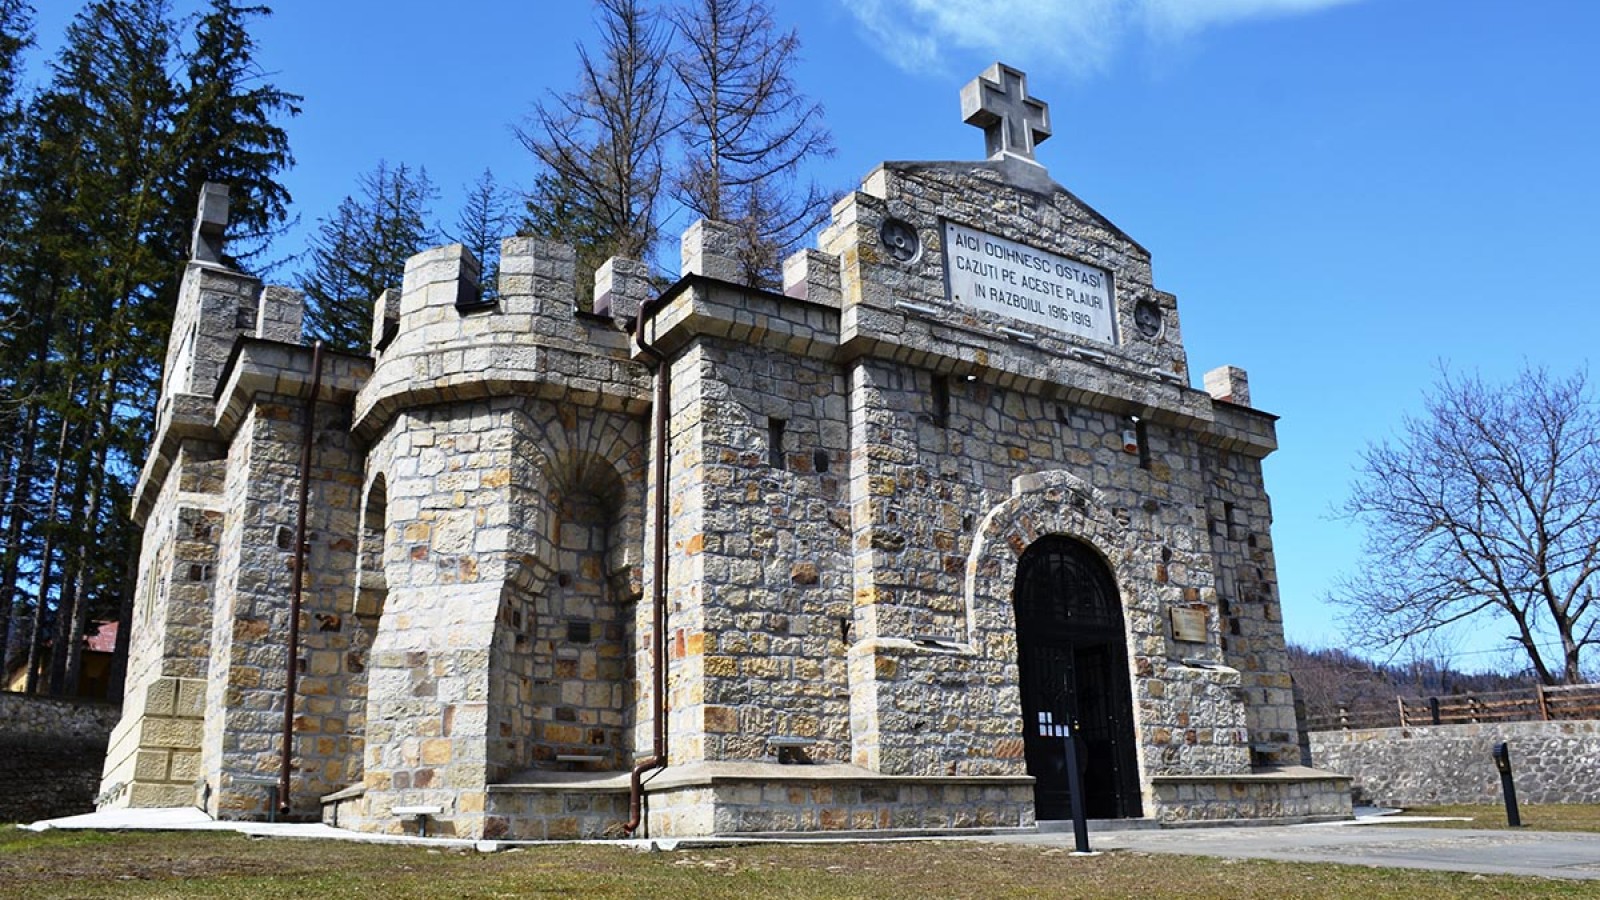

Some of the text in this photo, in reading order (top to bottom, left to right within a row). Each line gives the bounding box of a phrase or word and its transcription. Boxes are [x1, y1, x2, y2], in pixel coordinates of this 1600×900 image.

[956, 233, 1101, 288] AICI ODIHNESC OSTASI
[956, 255, 1104, 310] CAZUTI PE ACESTE PLAIURI
[974, 283, 986, 299] IN
[990, 287, 1046, 315] RAZBOIUL
